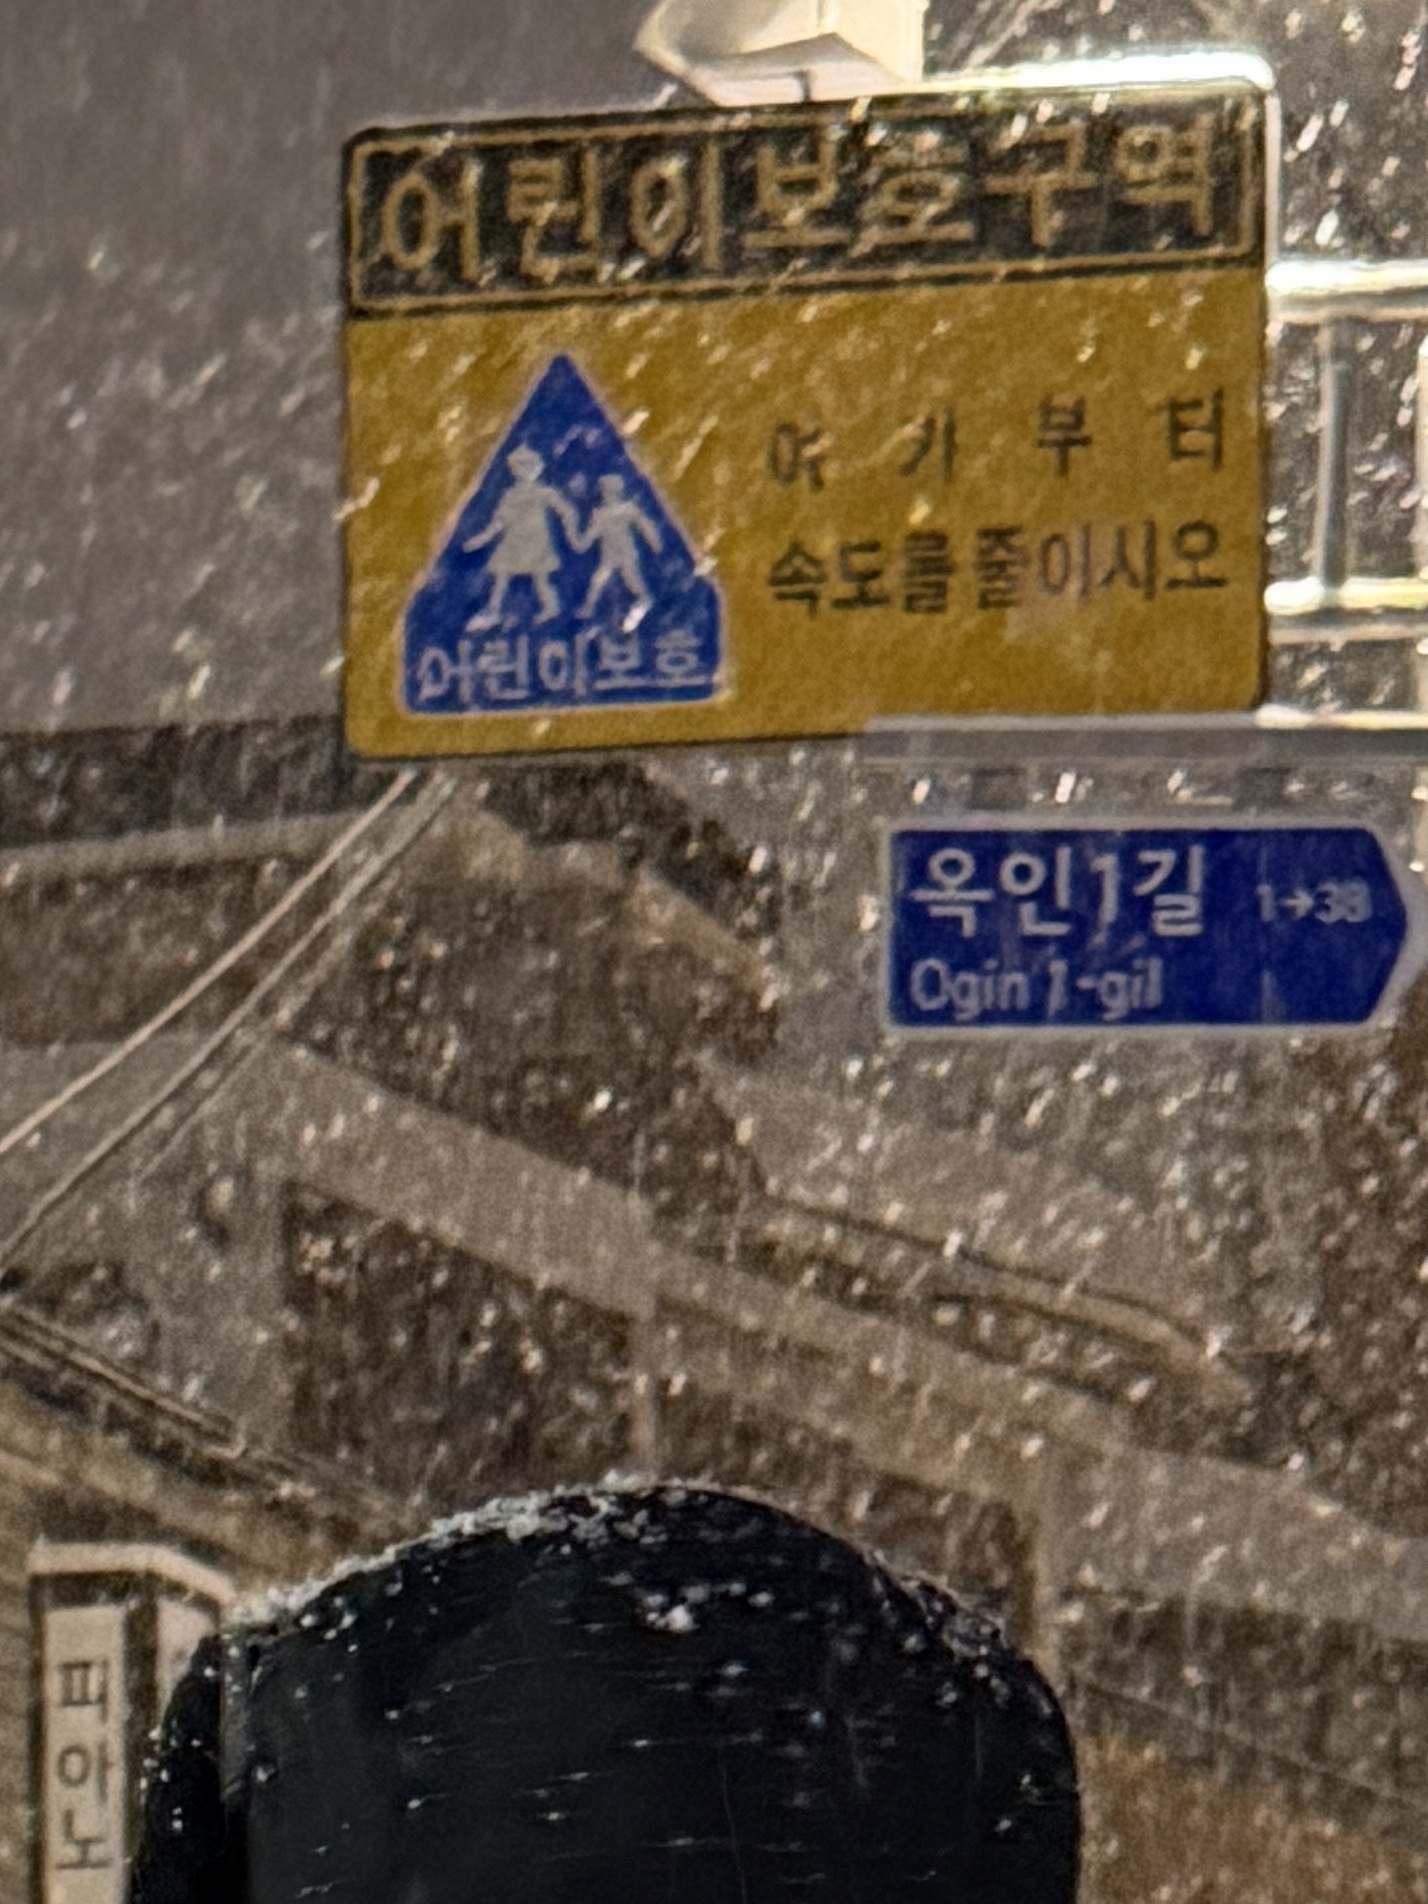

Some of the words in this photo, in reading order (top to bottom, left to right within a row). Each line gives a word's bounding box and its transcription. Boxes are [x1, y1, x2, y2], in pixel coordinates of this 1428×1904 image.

[382, 113, 1213, 283] 어린이보호구역
[417, 629, 708, 702] 어린이보호
[910, 845, 1205, 938] 옥인1길
[910, 957, 1029, 1022] Ogin
[55, 1657, 113, 1871] 피아노
